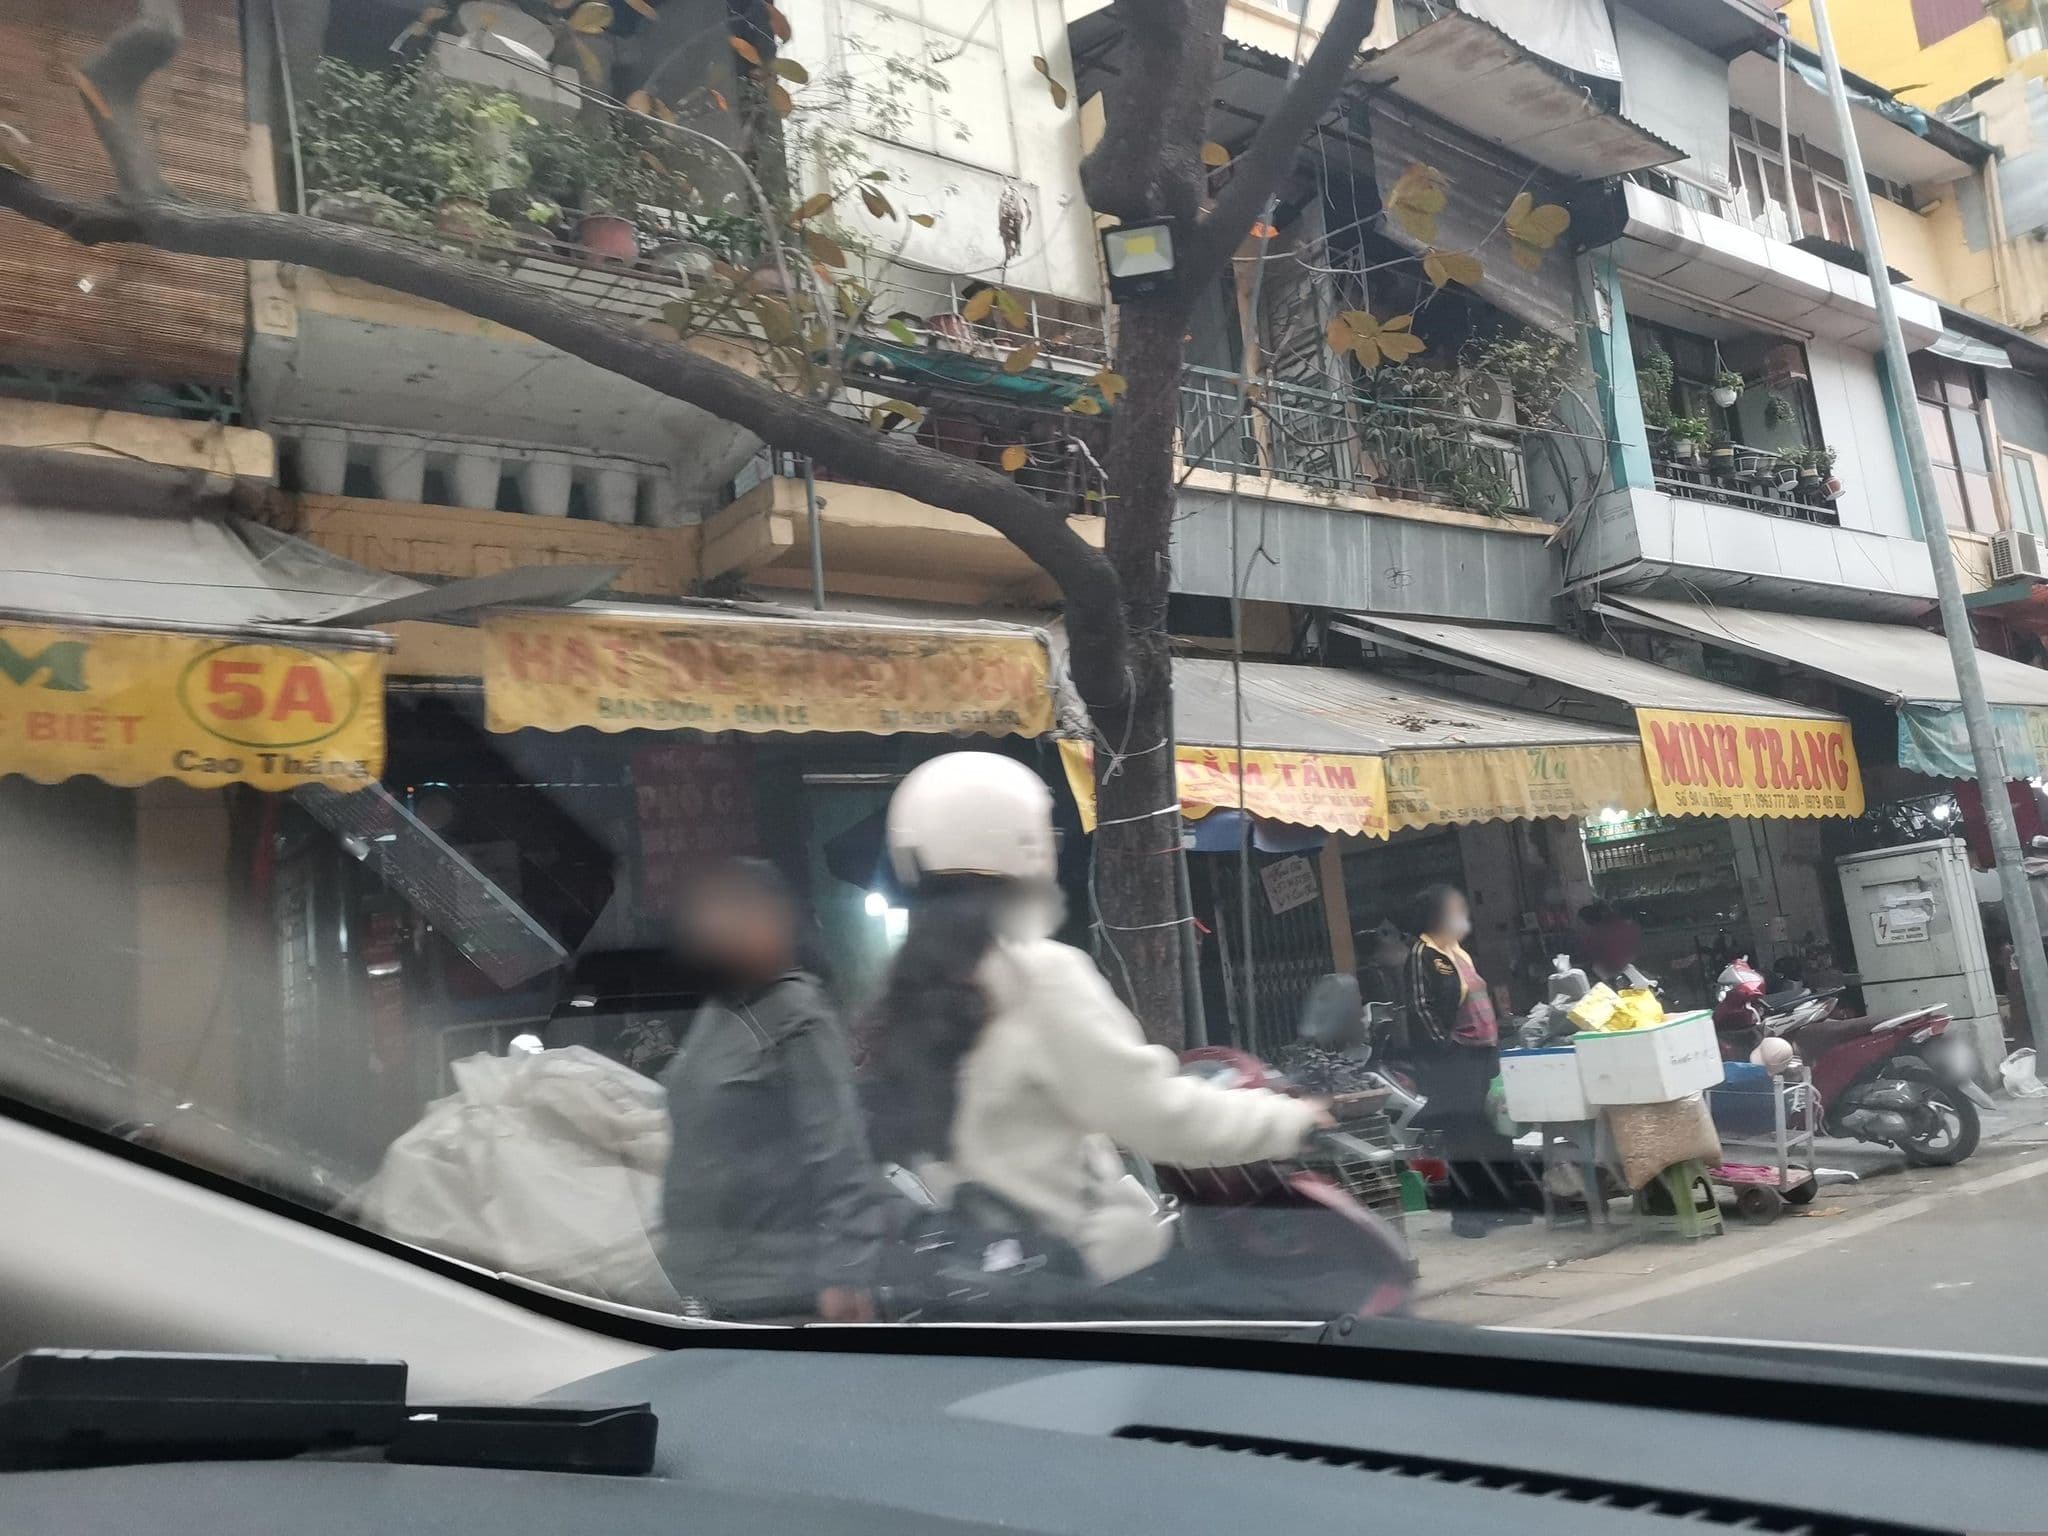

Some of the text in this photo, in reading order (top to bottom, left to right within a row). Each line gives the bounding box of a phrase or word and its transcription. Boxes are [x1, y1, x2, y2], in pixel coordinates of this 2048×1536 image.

[206, 660, 335, 724] 5A
[25, 704, 145, 751] BIỆT
[172, 749, 242, 774] Cao
[1650, 720, 1849, 791] MINH TRANG
